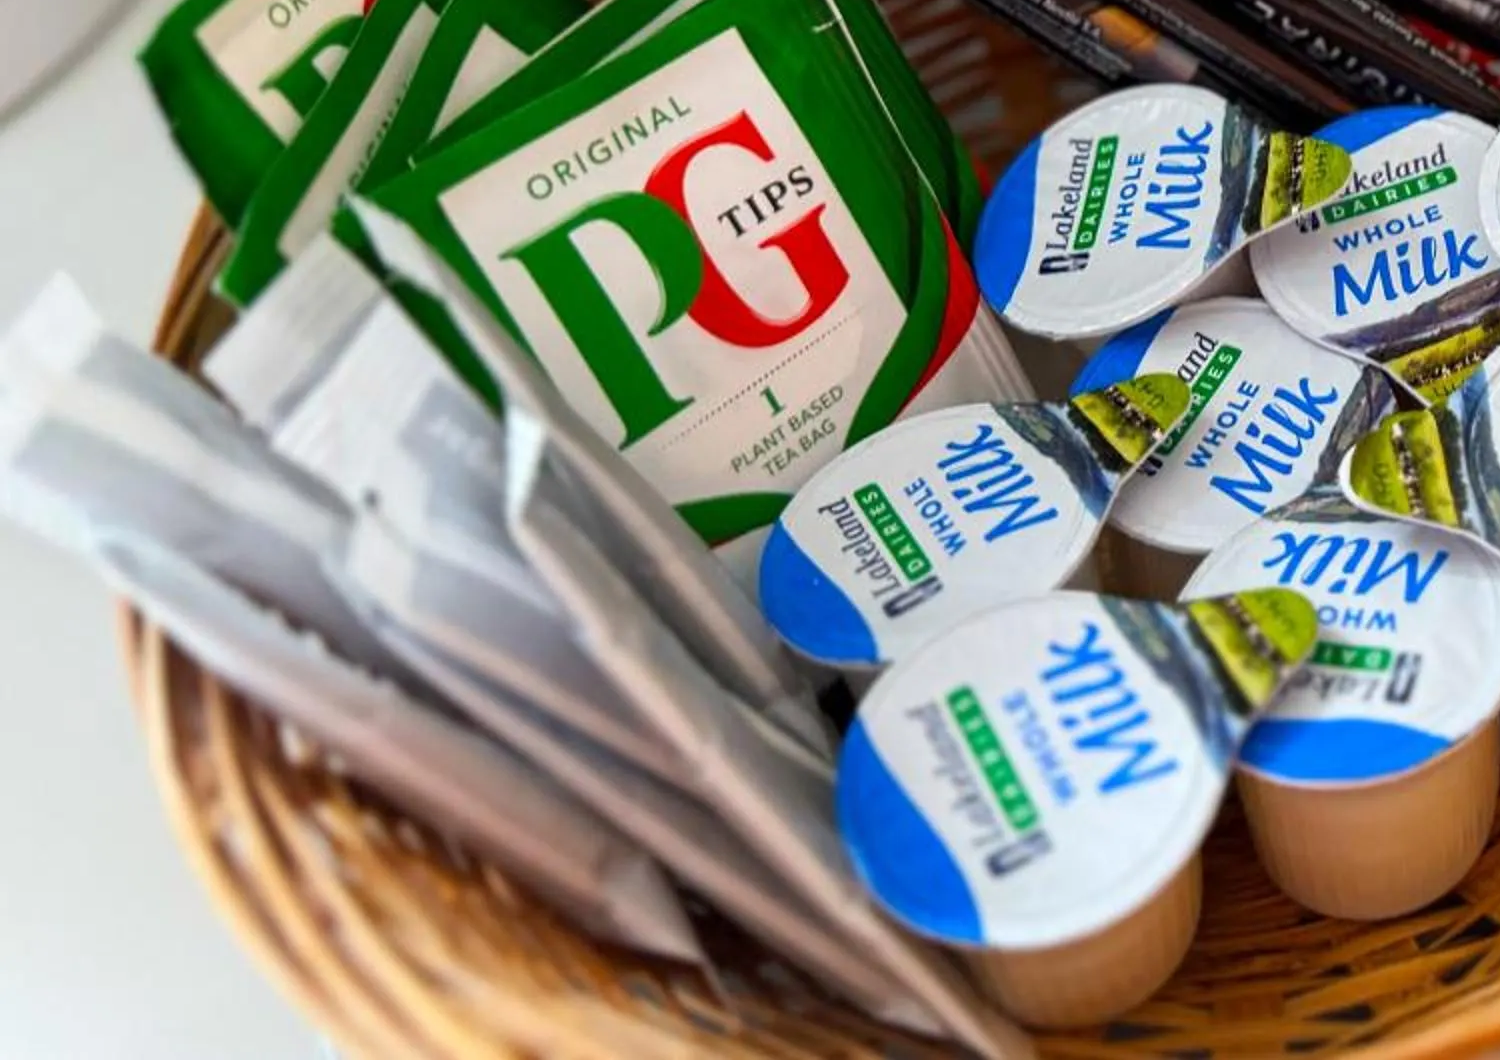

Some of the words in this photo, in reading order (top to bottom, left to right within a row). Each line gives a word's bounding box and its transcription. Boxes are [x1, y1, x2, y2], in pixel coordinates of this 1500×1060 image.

[526, 96, 691, 200] ORIGINAL
[1079, 140, 1114, 245] DAIRIES
[1135, 120, 1214, 251] Milk
[1340, 142, 1449, 200] keland
[716, 165, 815, 239] TIPS
[1050, 138, 1093, 254] Lakeland
[1108, 151, 1146, 245] WHOLE
[1331, 172, 1451, 220] DAIRIES
[1334, 205, 1443, 252] WHOLE
[498, 110, 850, 450] PG
[1334, 229, 1490, 317] Milk
[730, 415, 785, 473] PLANT
[788, 384, 844, 427] BASED
[758, 387, 785, 417] 1
[1186, 380, 1260, 470] WHOLE
[1209, 377, 1339, 516] Milk
[763, 444, 796, 476] TEA
[798, 421, 836, 453] BAG
[936, 424, 1059, 542] Milk
[818, 496, 900, 600] Lakeland
[864, 489, 926, 574] DAIRIES
[904, 477, 969, 557] WHOLE
[1263, 532, 1449, 603] Milk
[1316, 605, 1397, 631] WHO
[1039, 621, 1179, 795] Milk
